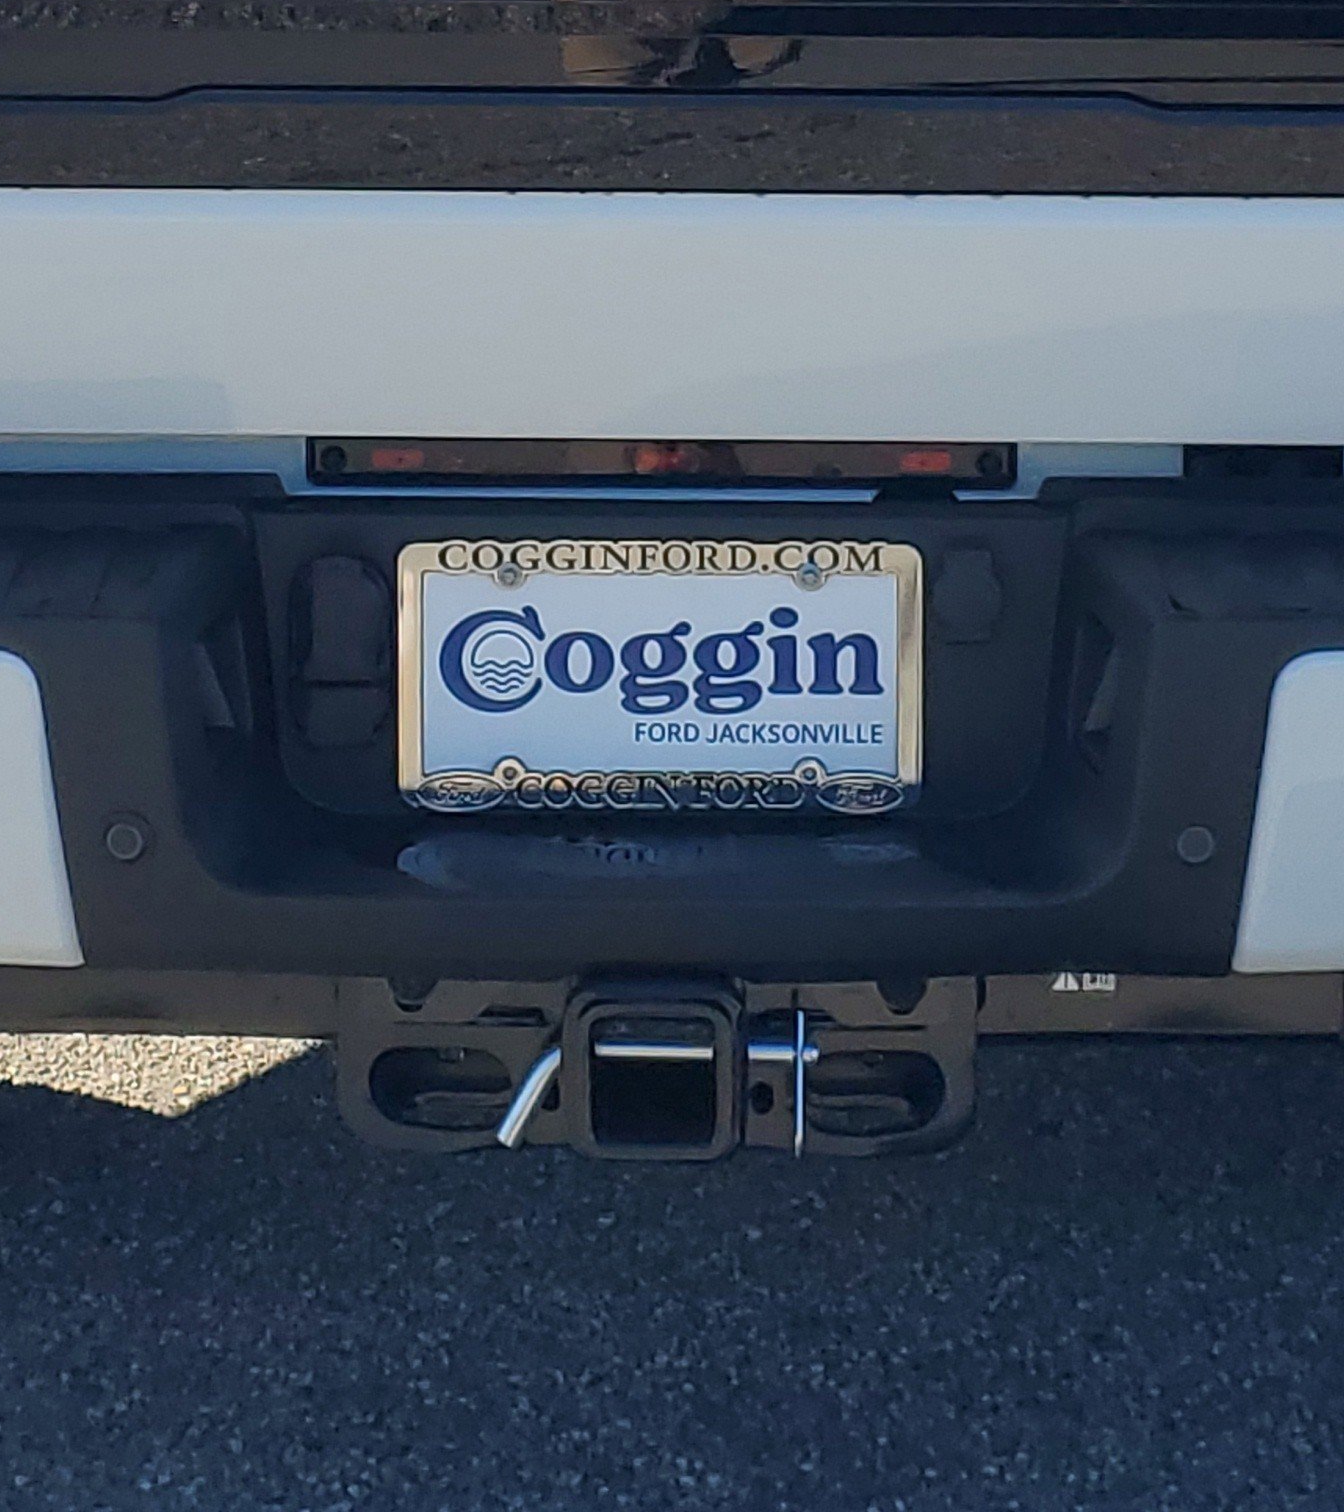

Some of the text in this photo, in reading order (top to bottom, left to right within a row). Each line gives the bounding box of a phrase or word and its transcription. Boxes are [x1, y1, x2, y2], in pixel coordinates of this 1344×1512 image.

[437, 544, 884, 572] COGGINFORD.COM
[439, 605, 885, 715] Coggin
[634, 722, 883, 744] FORD JACKSONVILLE
[516, 774, 684, 807] COGGIN
